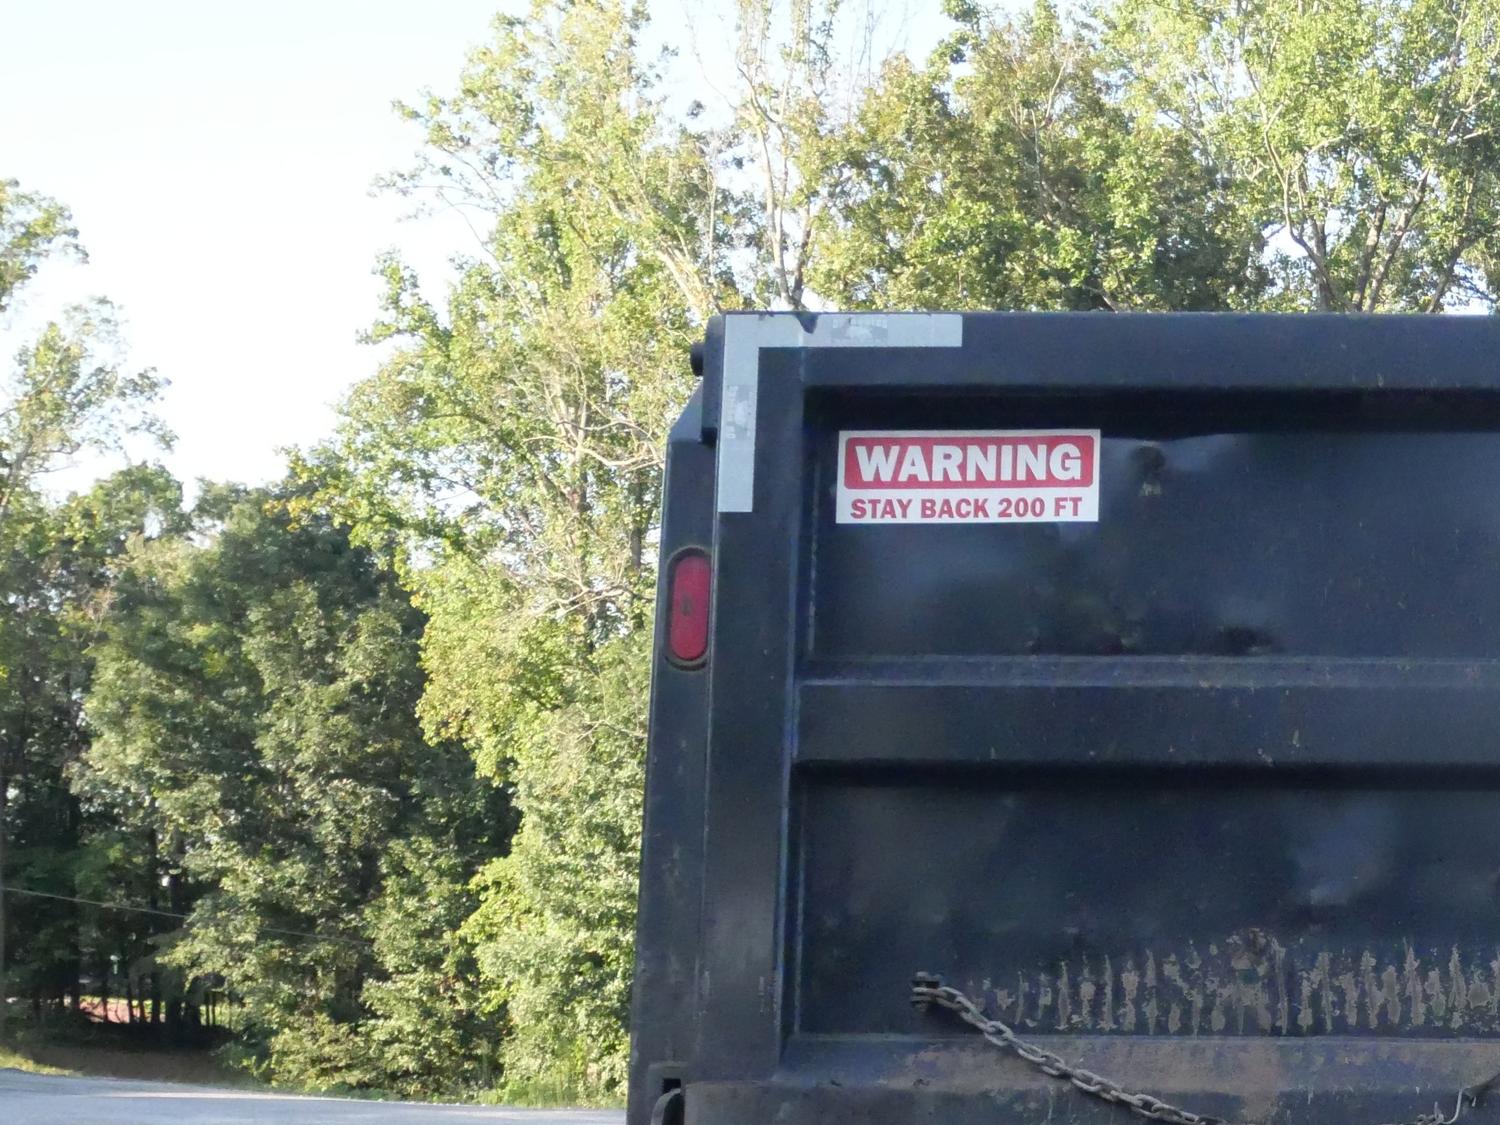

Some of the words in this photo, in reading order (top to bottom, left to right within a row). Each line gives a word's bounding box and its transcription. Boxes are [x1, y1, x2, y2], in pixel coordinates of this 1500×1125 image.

[855, 443, 1081, 482] WARNING
[851, 498, 912, 519] STAY
[920, 498, 989, 519] BACK
[997, 497, 1045, 518] 200
[1054, 497, 1082, 517] FT
